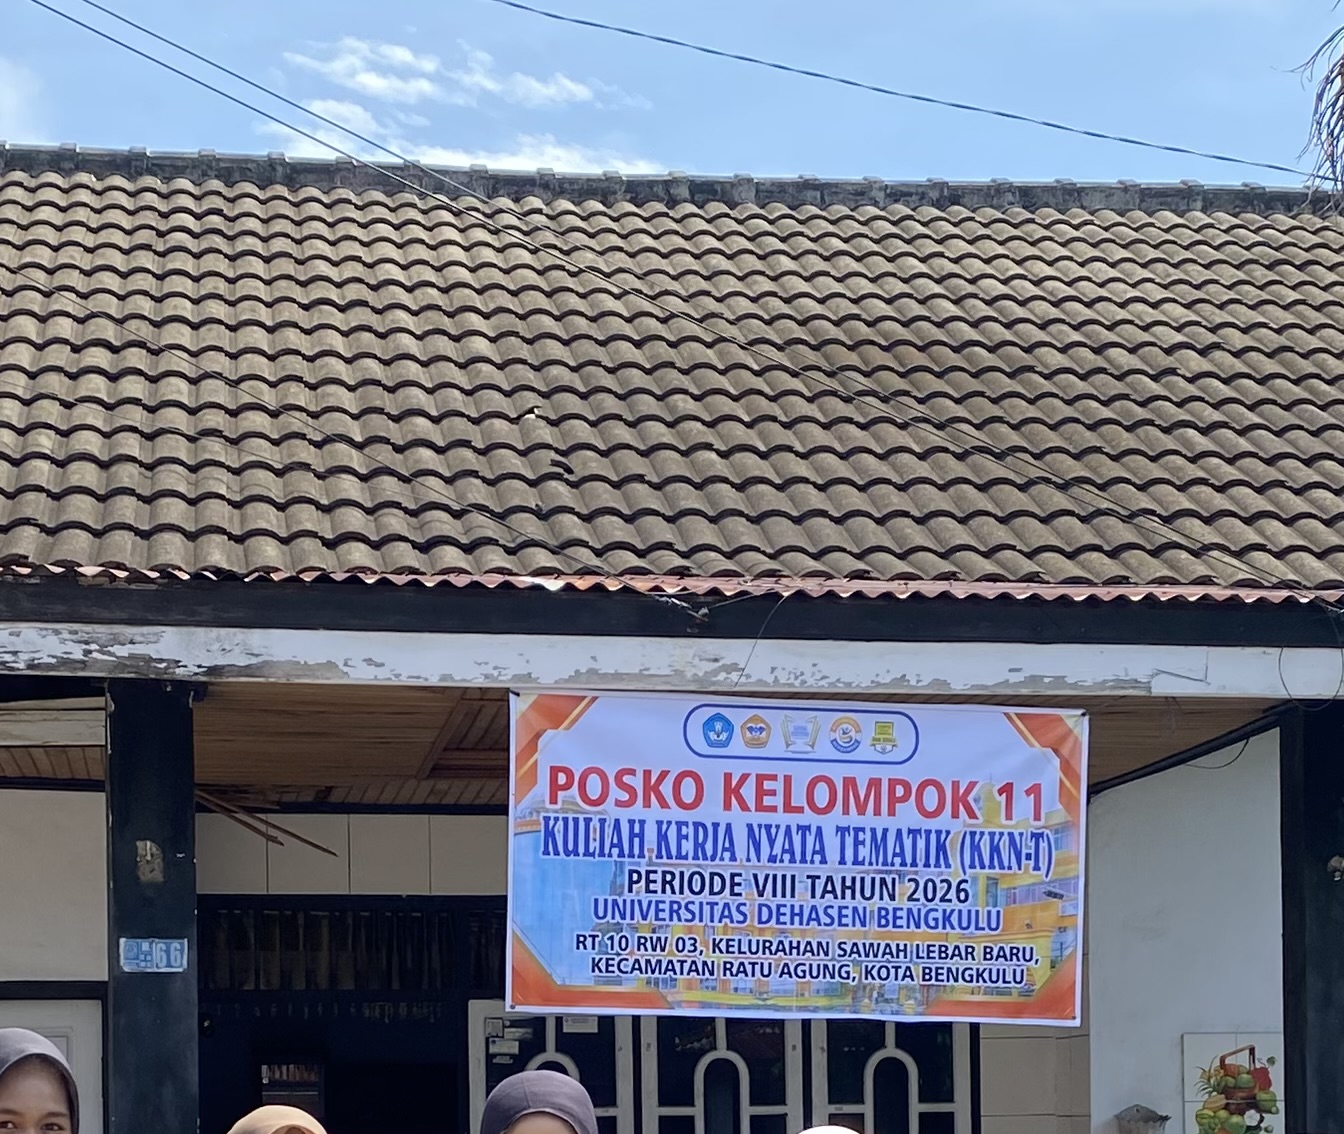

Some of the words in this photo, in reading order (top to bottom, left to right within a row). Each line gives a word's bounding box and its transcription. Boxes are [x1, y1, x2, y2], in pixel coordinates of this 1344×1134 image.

[548, 765, 704, 811] POSKO
[722, 771, 980, 821] KELOMPOK
[996, 782, 1042, 822] 11
[541, 815, 647, 859] KULIAH
[655, 819, 738, 862] KERJA
[745, 822, 828, 866] NYATA
[835, 825, 952, 869] TEMATIK
[959, 830, 1053, 879] (KKN-T)
[626, 869, 743, 897] PERIODE
[752, 873, 796, 899] VIII
[806, 874, 897, 902] TAHUN
[906, 877, 970, 904] 2026
[593, 897, 748, 925] UNIVERSITAS
[757, 903, 868, 929] DEHASEN
[877, 906, 1001, 932] BENGKULU
[157, 942, 182, 968] 66
[575, 934, 599, 951] RT
[606, 935, 629, 951] 10
[636, 935, 669, 952] RW
[675, 936, 704, 957] 03,
[712, 937, 830, 957] KELURAHAN
[837, 941, 908, 960] SAWAH
[915, 943, 976, 962] LEBAR
[983, 945, 1039, 966] BARU,
[591, 957, 715, 977] KECAMATAN
[722, 960, 772, 979] RATU
[778, 961, 857, 983] AGUNG,
[864, 964, 915, 982] KOTA
[922, 966, 1025, 985] BENGKULU
